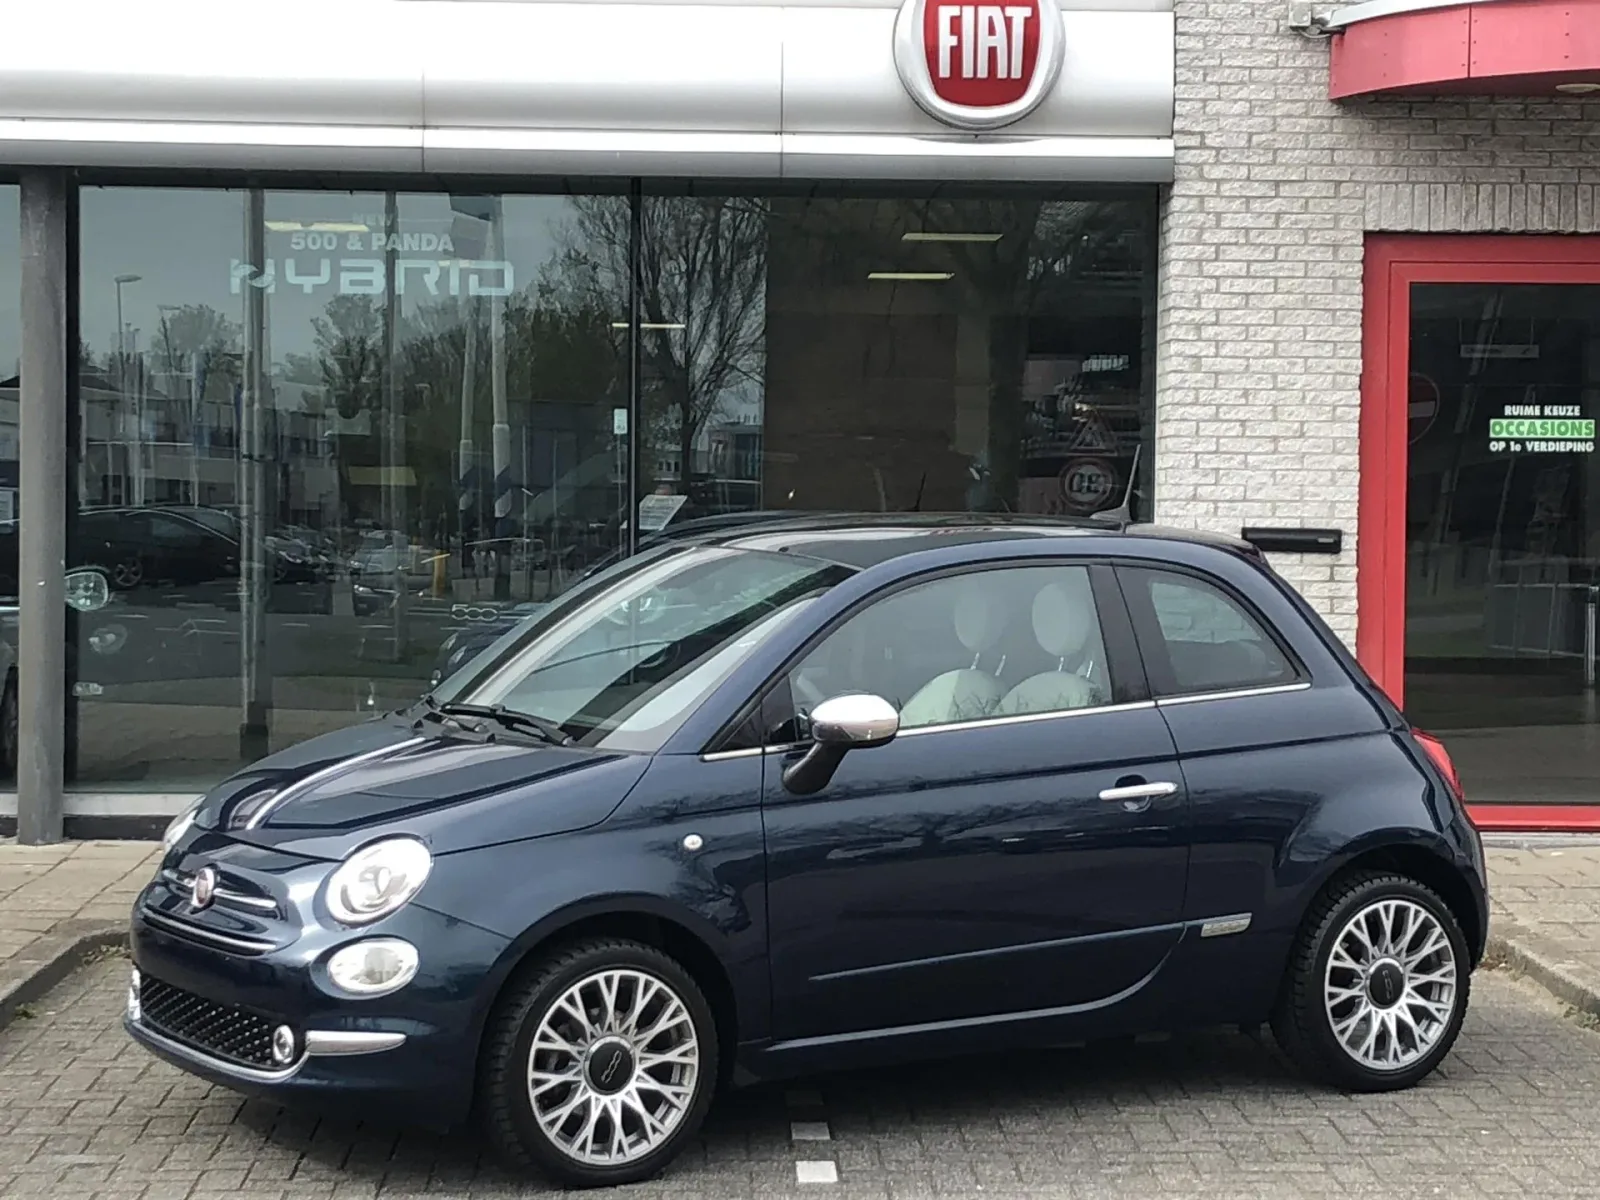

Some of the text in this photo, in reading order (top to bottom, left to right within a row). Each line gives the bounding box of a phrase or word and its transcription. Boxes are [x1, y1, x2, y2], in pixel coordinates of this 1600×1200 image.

[938, 5, 1032, 79] FIAT
[291, 233, 454, 251] 500 & PANDA
[230, 258, 515, 296] HYBRID
[1504, 405, 1580, 416] RUIME KEUZE
[1491, 421, 1593, 436] OCCASIONS
[1489, 441, 1506, 452] OP
[1526, 441, 1594, 452] VERDIEPING
